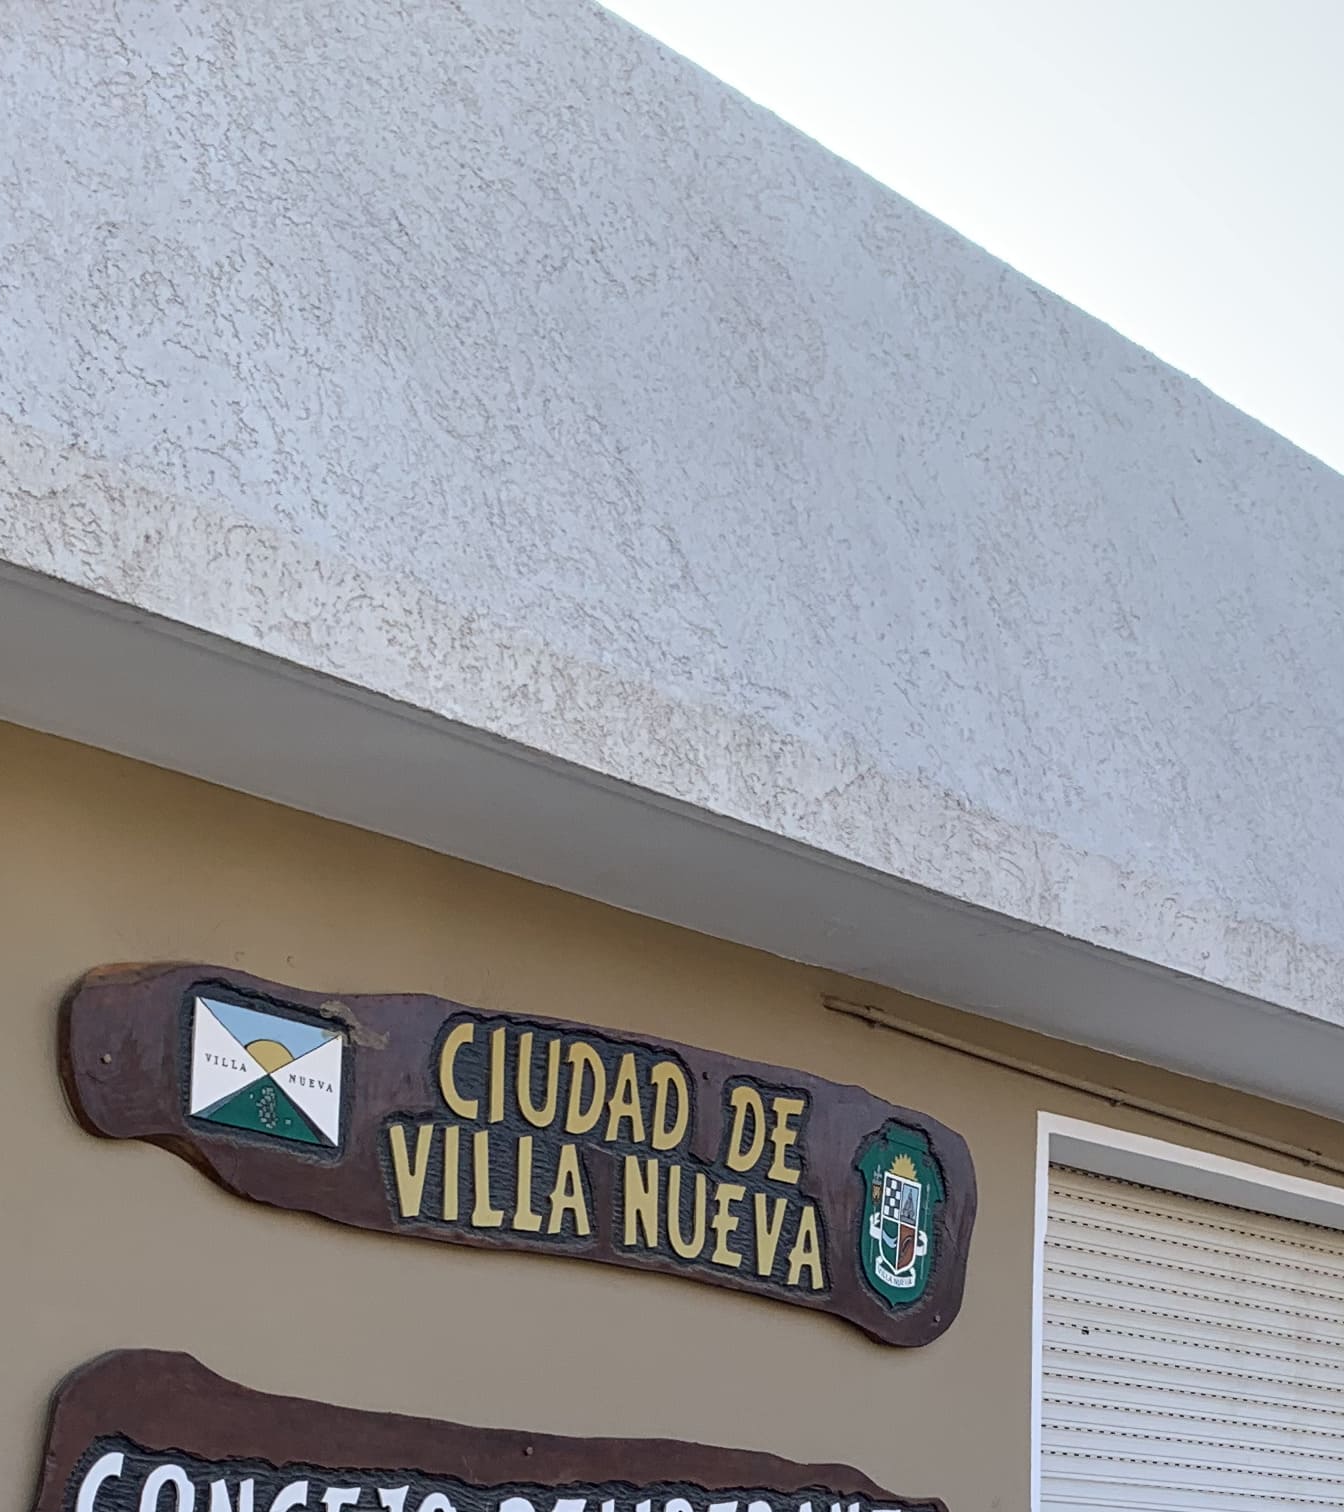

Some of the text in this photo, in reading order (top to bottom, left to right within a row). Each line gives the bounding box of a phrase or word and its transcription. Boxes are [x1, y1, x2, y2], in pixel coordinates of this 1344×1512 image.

[205, 1053, 334, 1093] VILLA NUEVA
[439, 1021, 806, 1185] CIUDAD DE
[388, 1123, 827, 1291] VILLA NUEVA
